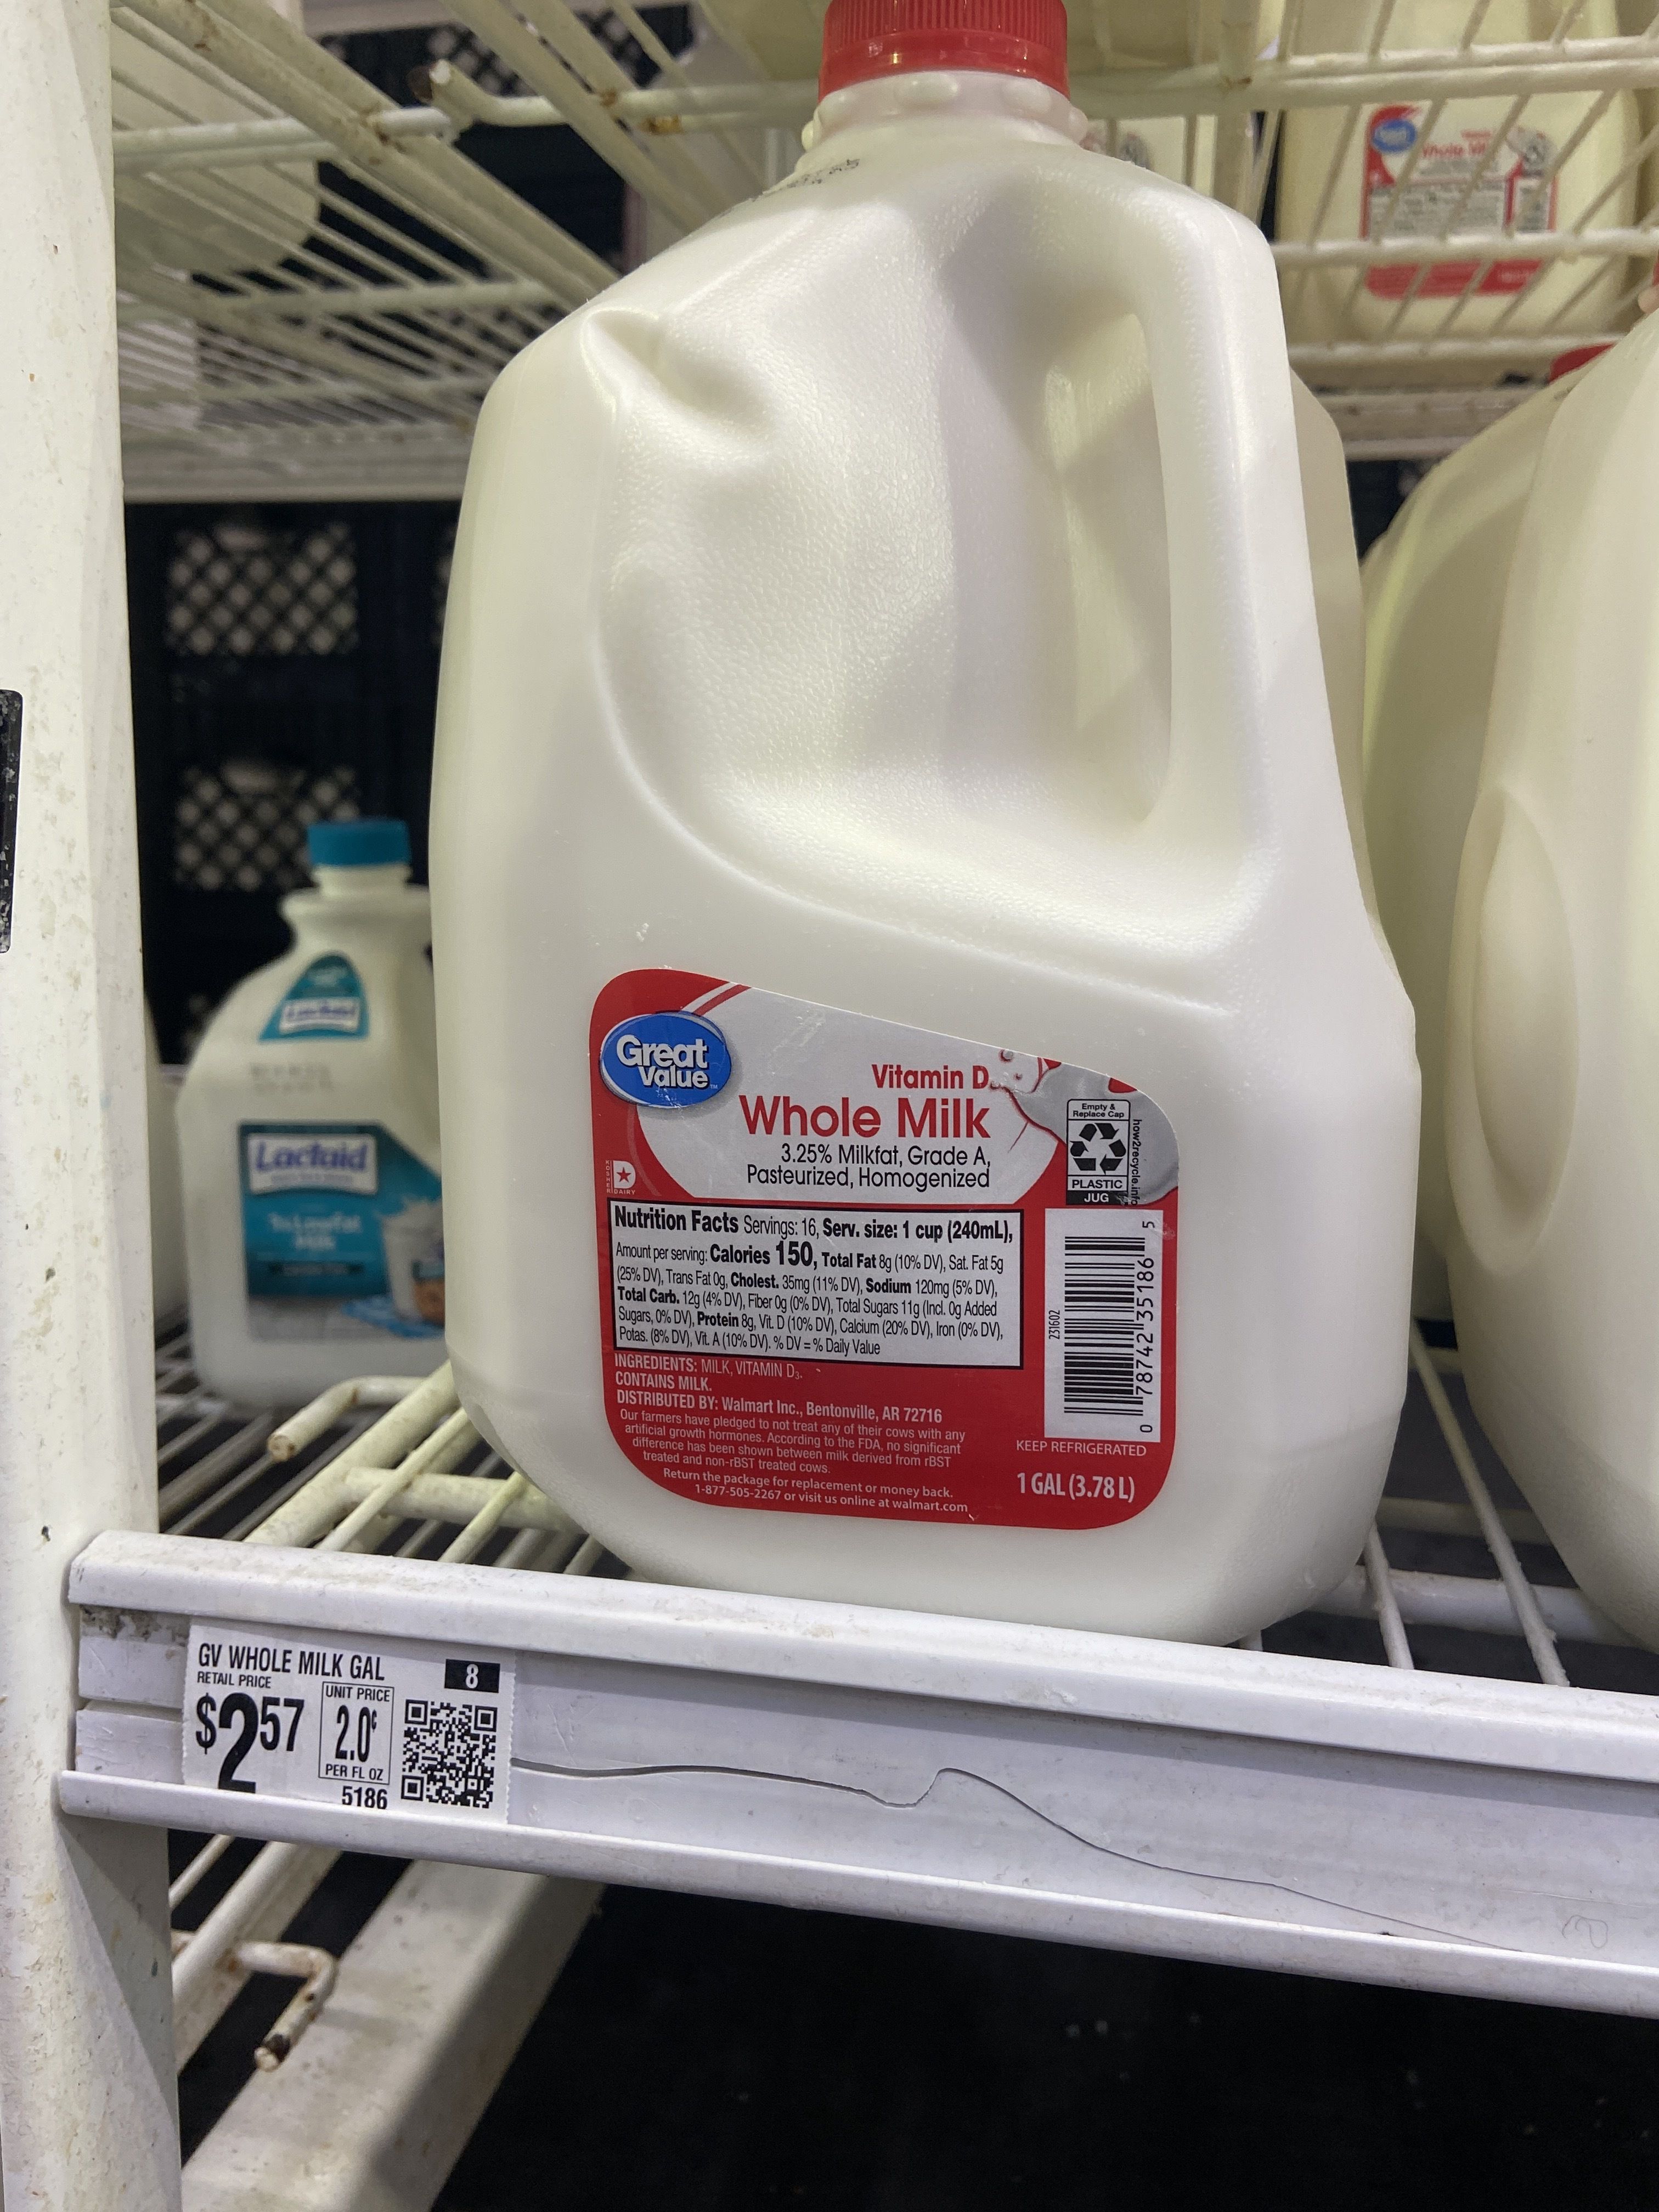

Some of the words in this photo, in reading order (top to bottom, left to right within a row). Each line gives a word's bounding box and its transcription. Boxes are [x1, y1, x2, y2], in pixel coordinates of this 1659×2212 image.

[617, 1035, 707, 1068] Great
[637, 1065, 708, 1087] Value
[872, 1065, 964, 1089] Vitamin
[972, 1066, 988, 1089] D
[739, 1095, 881, 1138] Whole
[898, 1095, 990, 1138] Milk
[256, 1141, 368, 1172] Lactaid
[781, 1144, 832, 1163] 3.25%
[838, 1143, 903, 1167] Milkfat,
[908, 1146, 968, 1166] Grade
[973, 1147, 991, 1169] A,
[1130, 1119, 1142, 1206] how2recycle.info
[747, 1165, 854, 1188] Pasteurized,
[858, 1169, 990, 1192] Homogenized
[1072, 1180, 1122, 1189] PLASTIC
[1084, 1193, 1109, 1203] JUG
[616, 1206, 686, 1231] Nutrition
[692, 1210, 738, 1233] Facts
[744, 1215, 798, 1240] Servings:
[802, 1218, 819, 1239] 16,
[823, 1218, 860, 1237] Serv.
[865, 1219, 898, 1238] size:
[903, 1221, 909, 1238] 1
[916, 1225, 943, 1243] cup
[948, 1220, 1012, 1243] (240mL),
[617, 1242, 651, 1259] Amount
[653, 1248, 668, 1263] per
[672, 1246, 707, 1265] serving:
[710, 1244, 770, 1264] Calories
[776, 1241, 817, 1271] 150,
[822, 1252, 853, 1267] Total
[857, 1253, 876, 1268] Fat
[879, 1254, 891, 1273] 8g
[895, 1254, 921, 1273] (10%
[924, 1254, 945, 1274] DV),
[949, 1255, 968, 1270] Sat.
[972, 1255, 988, 1270] Fat
[991, 1255, 1003, 1274] 5g
[618, 1266, 641, 1283] (25%
[643, 1267, 663, 1286] DV),
[666, 1269, 693, 1284] Trans
[696, 1271, 711, 1285] Fat
[713, 1272, 727, 1290] 0g,
[731, 1272, 779, 1288] Cholest.
[782, 1275, 809, 1294] 35mg
[813, 1276, 838, 1294] (11%
[842, 1277, 862, 1296] DV),
[866, 1278, 911, 1294] Sodium
[916, 1279, 949, 1299] 120mg
[953, 1279, 972, 1299] (5%
[976, 1279, 997, 1299] DV),
[1136, 1257, 1154, 1321] 35186
[618, 1286, 646, 1301] Total
[650, 1288, 679, 1304] Carb.
[683, 1290, 699, 1309] 12g
[703, 1291, 721, 1309] (4%
[724, 1292, 745, 1311] DV),
[748, 1293, 772, 1308] Fiber
[775, 1295, 787, 1313] 0g
[791, 1295, 809, 1313] (0%
[812, 1296, 833, 1315] DV),
[836, 1297, 860, 1313] Total
[864, 1299, 898, 1317] Sugars
[902, 1300, 919, 1319] 11g
[923, 1300, 945, 1318] (Incl.
[949, 1301, 961, 1319] 0g
[964, 1301, 997, 1316] Added
[1048, 1309, 1060, 1340] 231602
[620, 1326, 647, 1342] Potas.
[651, 1328, 669, 1346] (8%
[672, 1330, 692, 1347] DV),
[695, 1331, 709, 1345] Vit.
[713, 1332, 720, 1346] A
[723, 1332, 747, 1350] (10%
[750, 1334, 771, 1352] DV).
[774, 1336, 783, 1350] %
[787, 1336, 801, 1350] DV
[813, 1338, 823, 1352] %
[826, 1338, 849, 1357] Daily
[853, 1339, 880, 1355] Value
[615, 1353, 697, 1372] INGREDIENTS:
[702, 1359, 732, 1376] MILK,
[735, 1361, 782, 1377] VITAMIN
[1136, 1333, 1154, 1396] 78742
[616, 1371, 675, 1389] CONTAINS
[679, 1376, 712, 1391] MILK.
[617, 1390, 695, 1408] DISTRIBUTED
[699, 1396, 718, 1410] BY:
[722, 1397, 774, 1413] Walmart
[777, 1400, 803, 1418] Inc.,
[806, 1402, 878, 1422] Bentonville,
[882, 1407, 899, 1421] AR
[904, 1408, 941, 1423] 72716
[620, 1409, 638, 1420] Our
[641, 1410, 681, 1424] farmers
[685, 1414, 710, 1425] have
[714, 1416, 755, 1430] pledged
[759, 1418, 769, 1429] to
[773, 1420, 789, 1430] not
[793, 1420, 817, 1432] treat
[821, 1424, 840, 1436] any
[844, 1424, 854, 1434] of
[858, 1425, 882, 1436] their
[886, 1429, 914, 1438] cows
[918, 1429, 941, 1439] with
[946, 1431, 965, 1442] any
[1140, 1424, 1153, 1433] 0
[1017, 1440, 1047, 1452] KEEP
[1051, 1441, 1147, 1457] REFRIGERATED
[664, 1468, 699, 1480] Return
[703, 1471, 720, 1482] the
[724, 1474, 770, 1487] package
[773, 1476, 788, 1487] for
[792, 1479, 862, 1492] replacement
[881, 1486, 919, 1498] money
[923, 1486, 953, 1498] back.
[1017, 1472, 1025, 1493] 1
[1031, 1472, 1065, 1496] GAL
[1069, 1474, 1115, 1500] (3.78
[1119, 1476, 1135, 1503] L)
[696, 1485, 781, 1499] 1-877-505-2267
[799, 1492, 821, 1503] visit
[840, 1496, 875, 1506] online
[879, 1499, 889, 1508] at
[893, 1499, 967, 1512] walmart.com
[199, 1643, 222, 1667] GV
[229, 1645, 291, 1673] WHOLE
[298, 1650, 343, 1677] MILK
[350, 1655, 385, 1680] GAL
[465, 1664, 479, 1689] 8
[198, 1672, 234, 1686] RETAIL
[239, 1675, 272, 1689] PRICE
[326, 1685, 352, 1700] UNIT
[357, 1688, 390, 1702] PRICE
[325, 1764, 348, 1778] PER
[352, 1767, 365, 1780] FL
[369, 1768, 383, 1781] OZ
[342, 1786, 387, 1810] 5186
